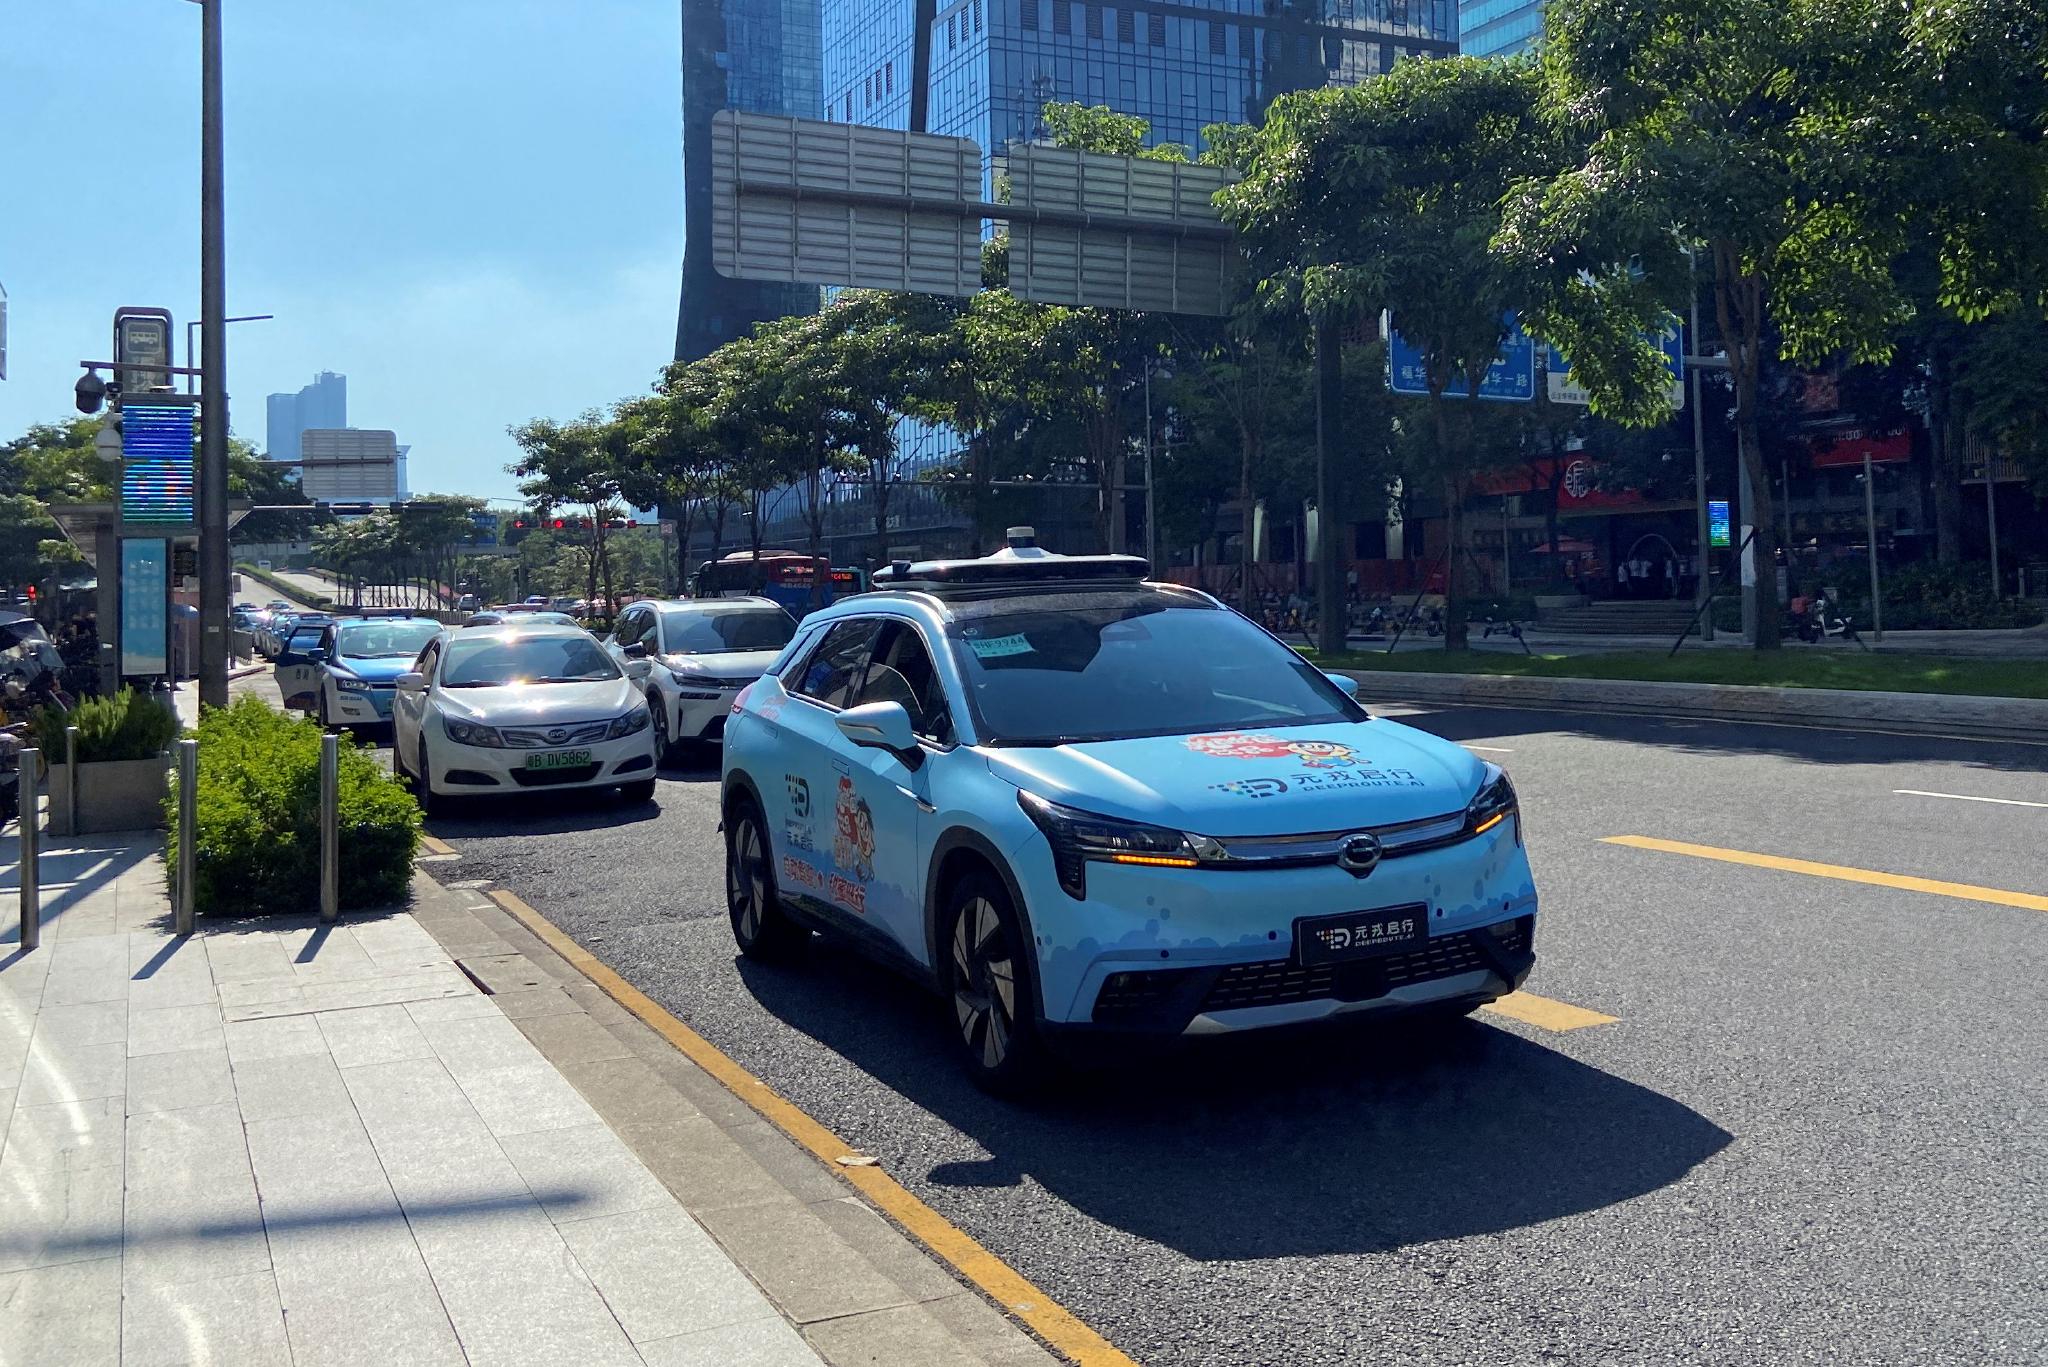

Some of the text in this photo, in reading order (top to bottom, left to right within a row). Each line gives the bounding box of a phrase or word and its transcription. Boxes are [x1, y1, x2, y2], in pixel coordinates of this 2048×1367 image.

[547, 750, 590, 766] DV5862
[1290, 768, 1415, 785] 元戎启行
[1355, 918, 1414, 940] 元戎启行
